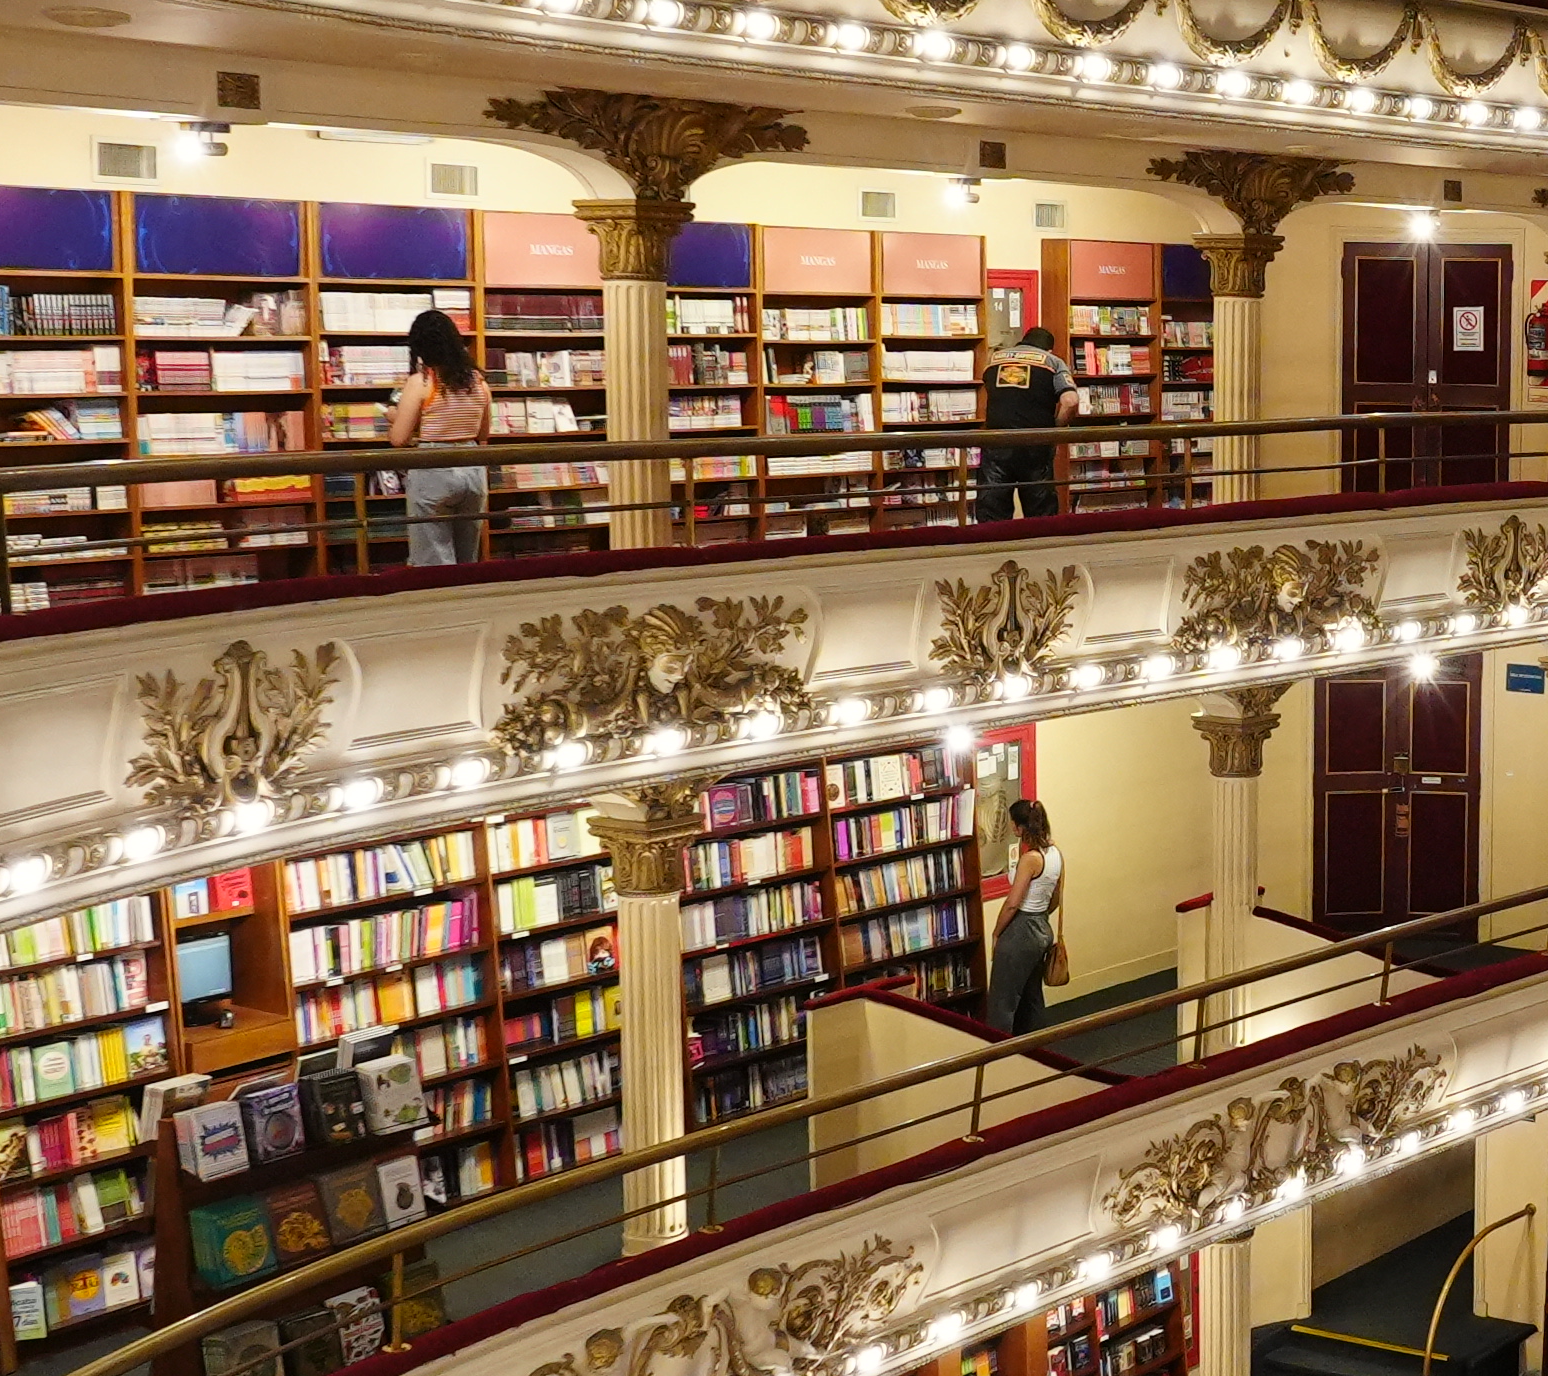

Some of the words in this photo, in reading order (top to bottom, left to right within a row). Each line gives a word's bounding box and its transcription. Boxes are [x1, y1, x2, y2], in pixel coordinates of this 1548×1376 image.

[530, 244, 574, 257] MANGAS
[800, 255, 836, 267] MANGAS
[916, 259, 948, 270] MANGAS
[1098, 265, 1126, 274] MANGAS
